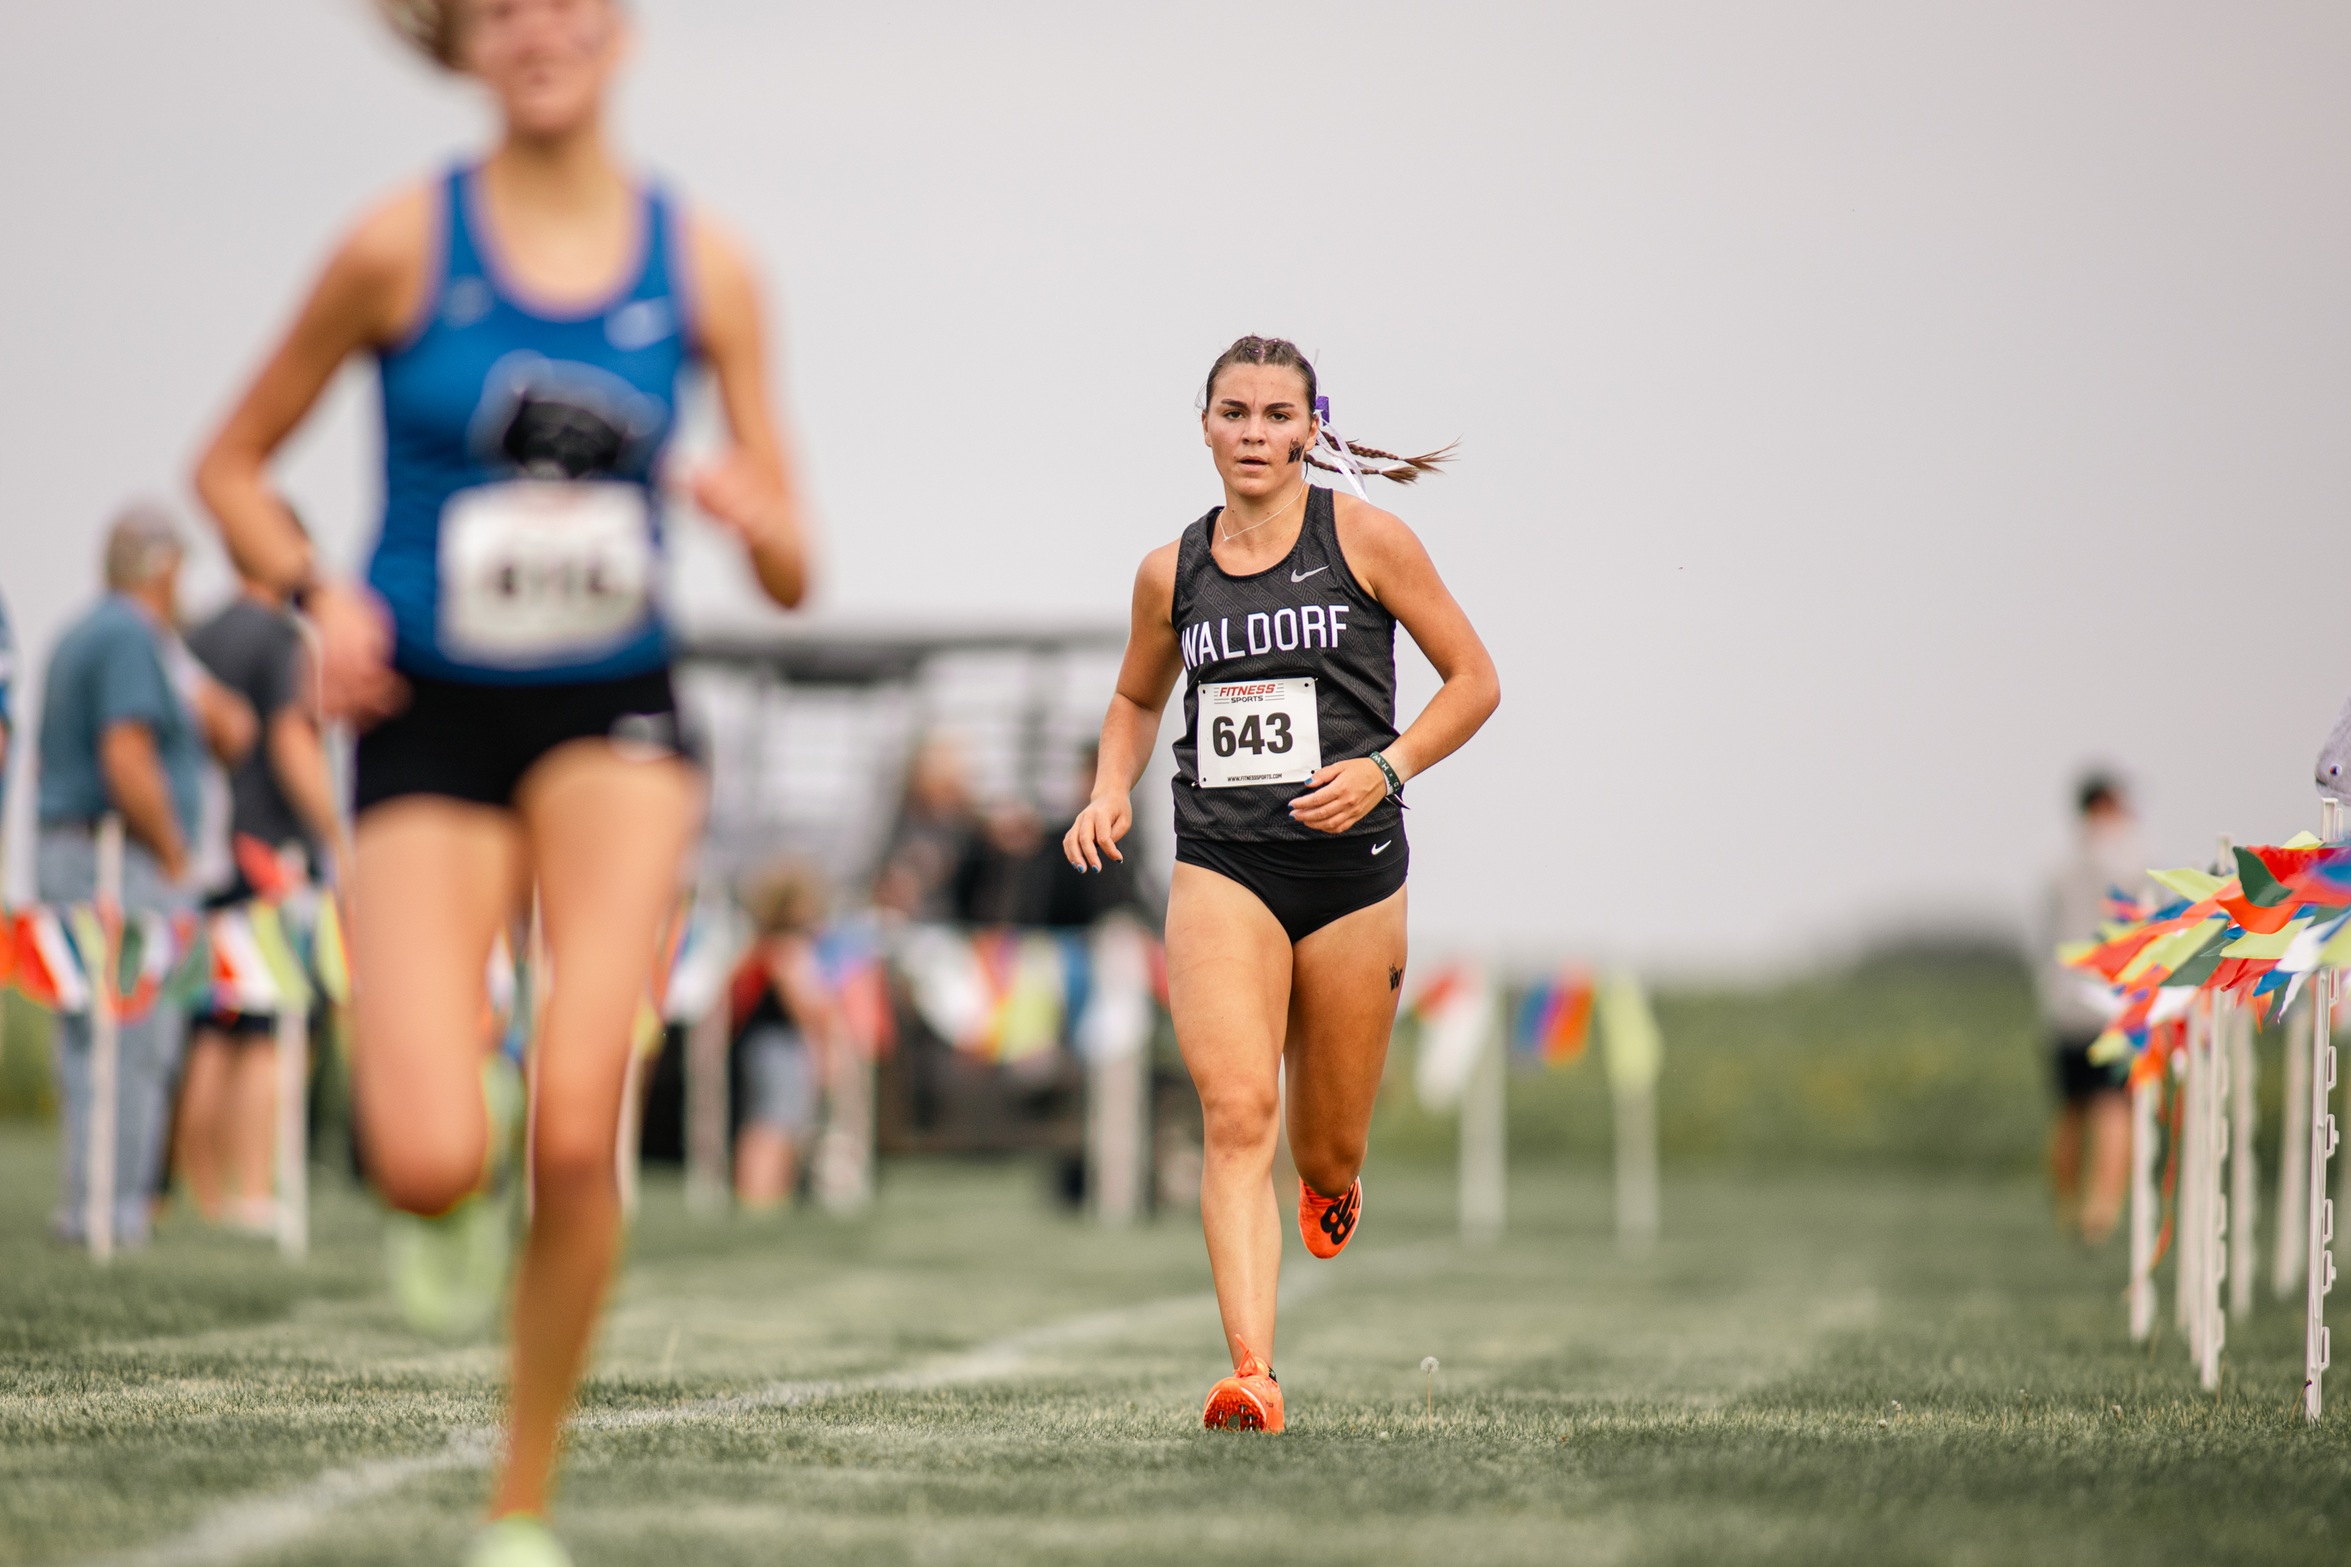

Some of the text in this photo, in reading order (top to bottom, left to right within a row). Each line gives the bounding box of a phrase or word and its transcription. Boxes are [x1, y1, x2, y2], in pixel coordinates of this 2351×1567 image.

[1181, 605, 1350, 671] WALDORF
[1219, 683, 1276, 697] FITNESS
[1231, 695, 1264, 704] SPORTS
[1212, 711, 1294, 758] 643
